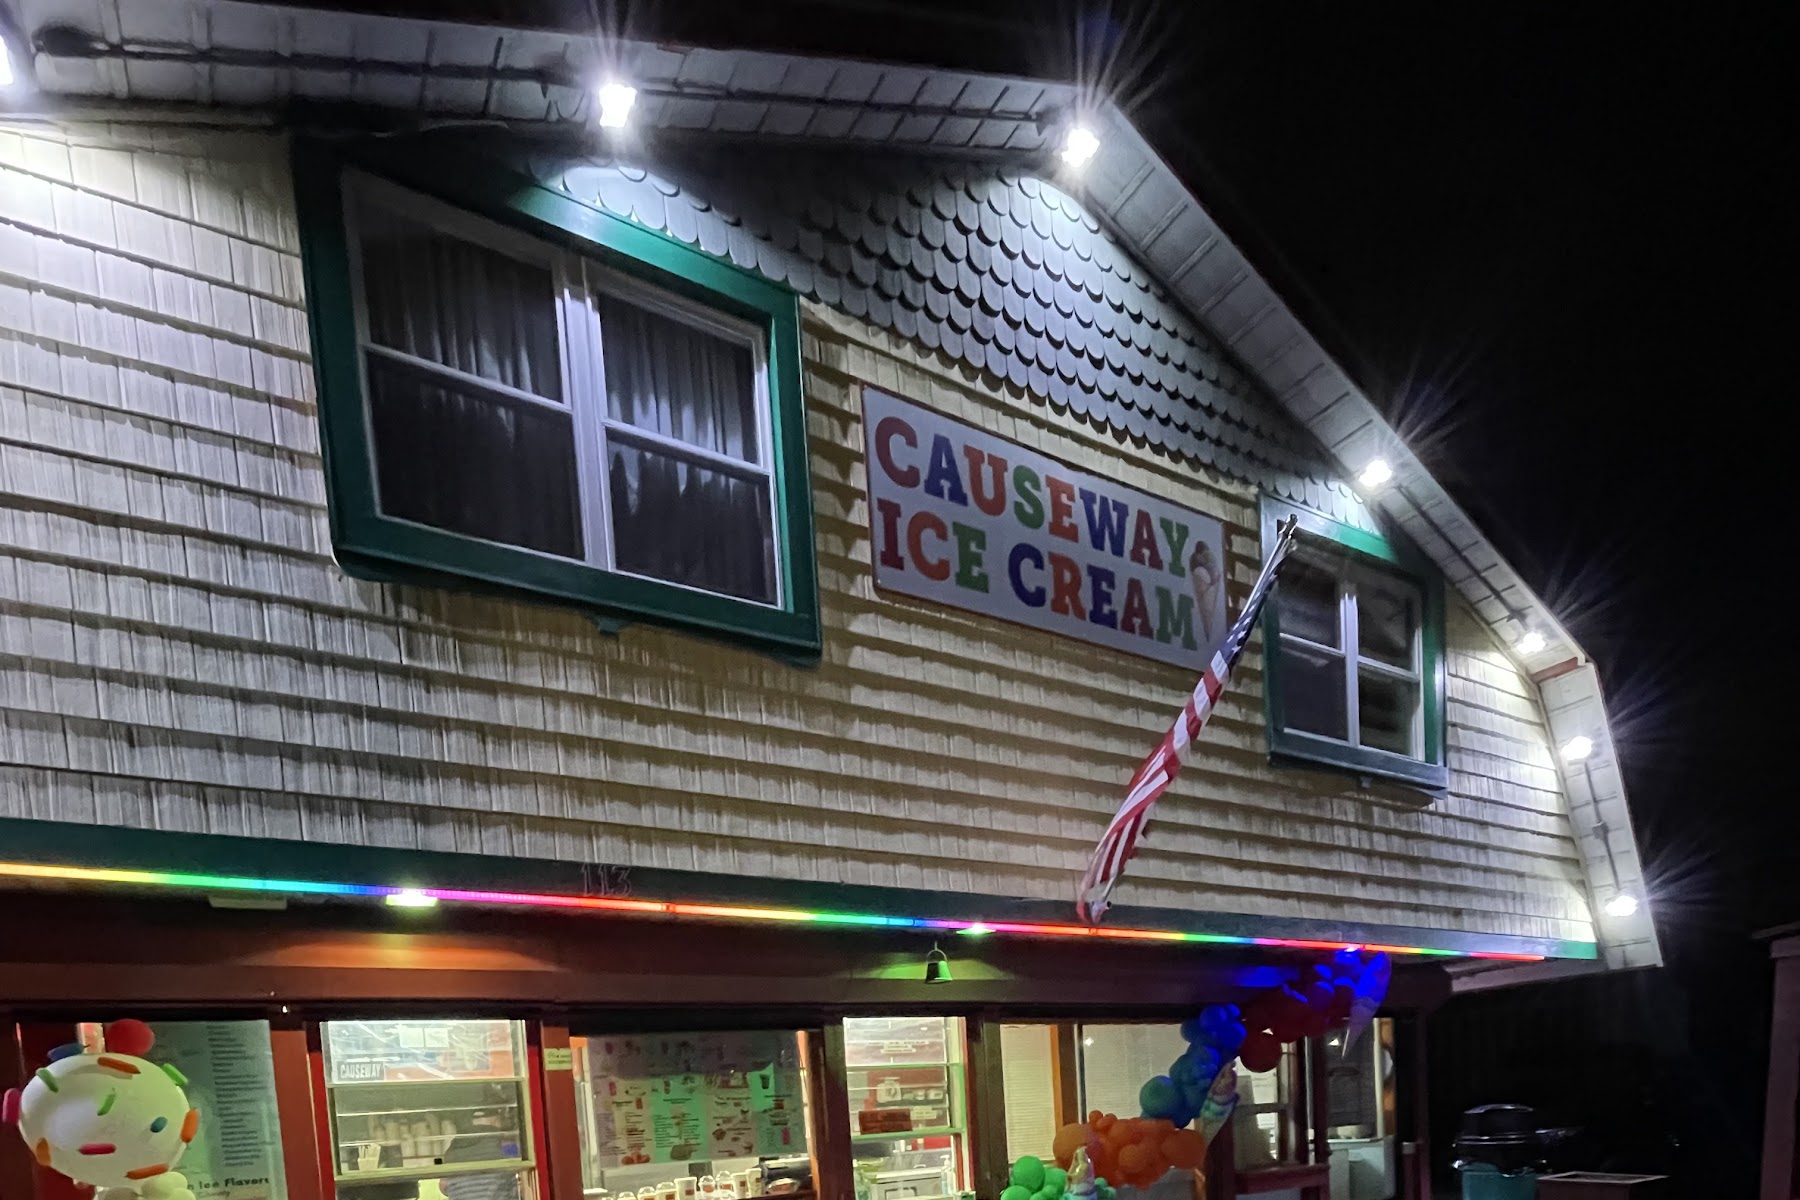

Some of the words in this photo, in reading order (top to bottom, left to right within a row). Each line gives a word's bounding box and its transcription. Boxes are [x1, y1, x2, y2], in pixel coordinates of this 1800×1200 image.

[875, 416, 1190, 578] CAUSEWAY
[877, 497, 990, 594] ICE
[1008, 542, 1198, 651] CREAM
[340, 1063, 382, 1079] CAUSEWAY
